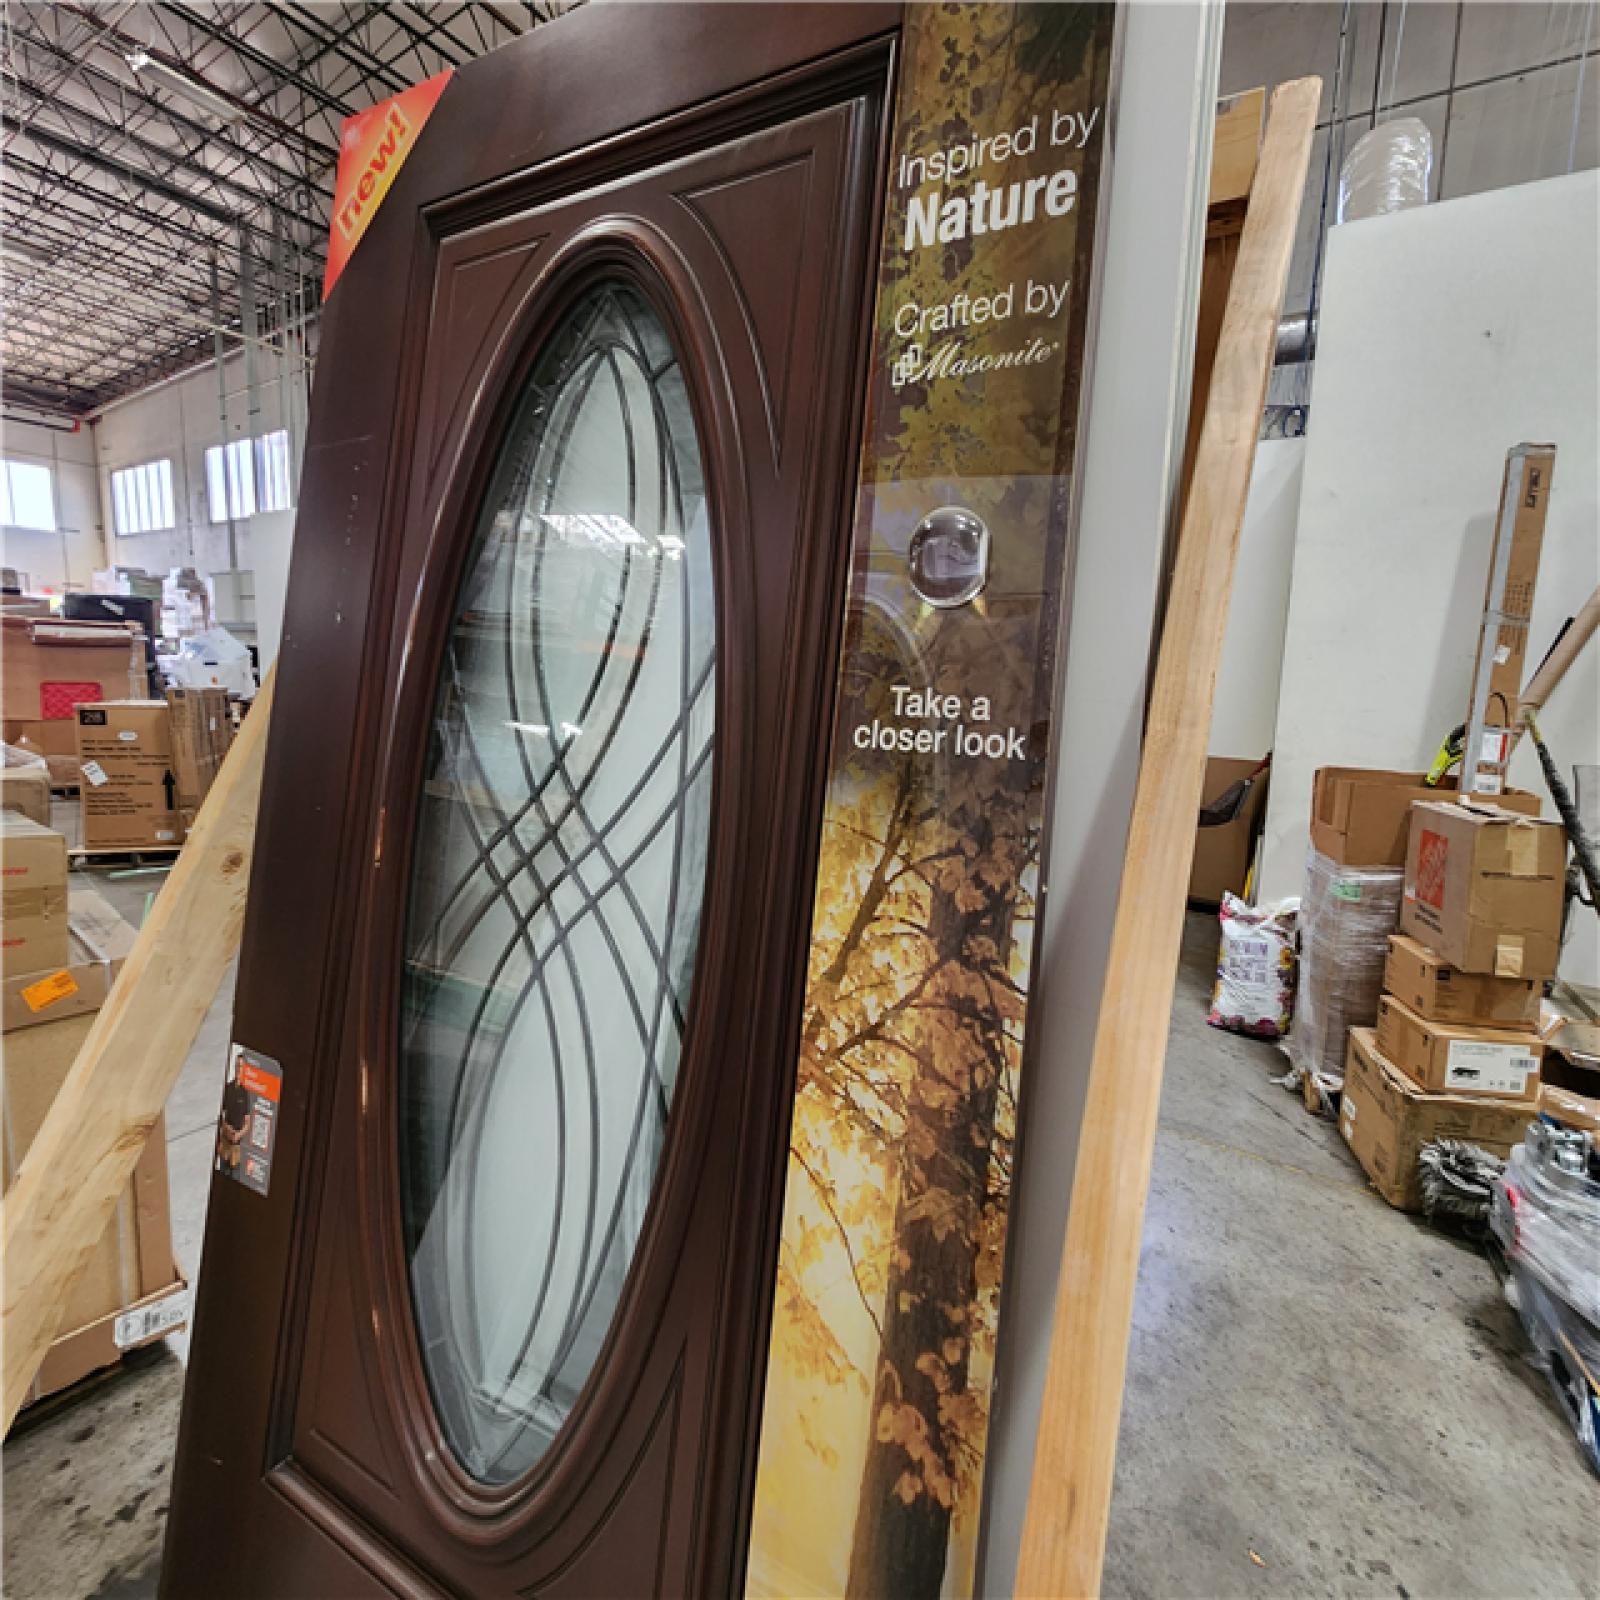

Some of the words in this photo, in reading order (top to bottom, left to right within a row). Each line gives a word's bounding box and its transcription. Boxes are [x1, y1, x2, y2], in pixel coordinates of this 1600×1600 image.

[900, 115, 1038, 188] Inspired
[1050, 106, 1100, 148] by
[904, 169, 1076, 251] Nature
[895, 283, 1014, 337] Crafted
[1025, 279, 1070, 318] by
[908, 337, 1053, 383] Masonite
[890, 684, 961, 719] Take
[971, 696, 991, 721] a
[854, 719, 948, 754] closer
[954, 724, 1026, 760] look
